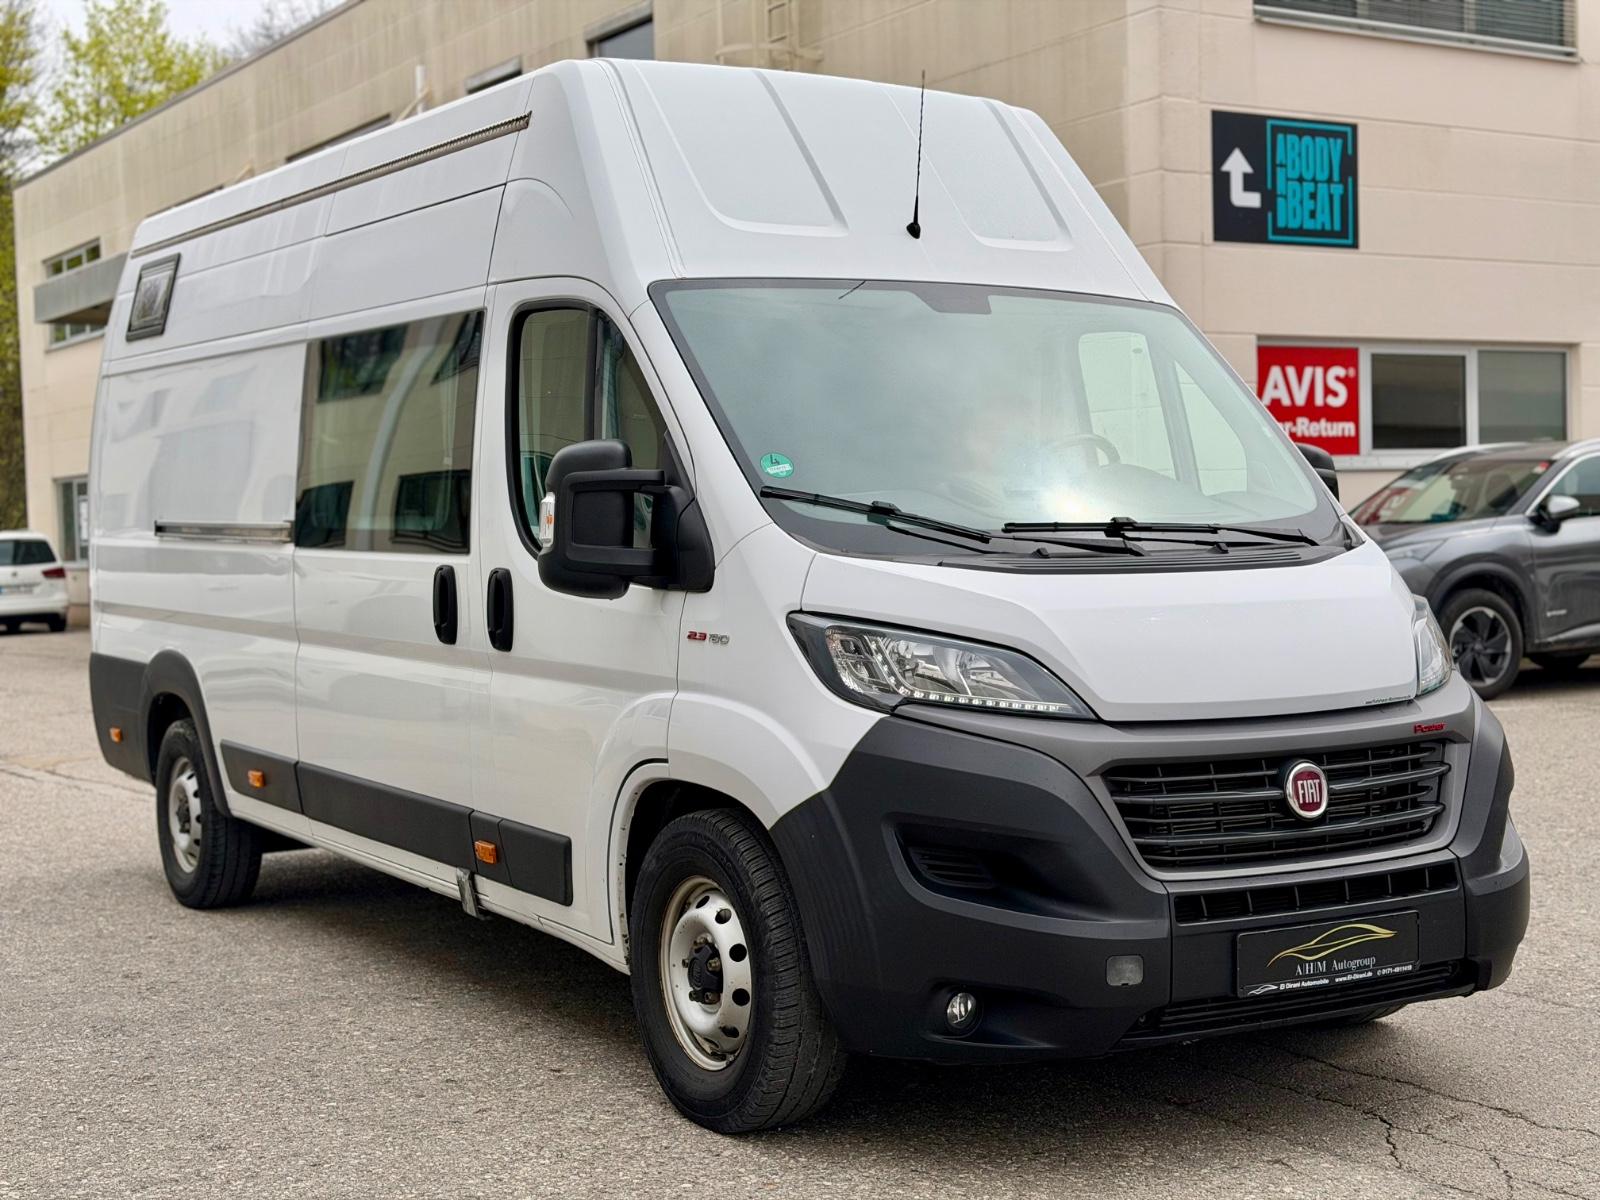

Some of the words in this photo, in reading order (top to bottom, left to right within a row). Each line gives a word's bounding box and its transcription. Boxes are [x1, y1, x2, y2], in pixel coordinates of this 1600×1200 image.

[1286, 134, 1343, 181] BODY
[1287, 181, 1344, 231] BEAT
[1261, 365, 1348, 407] AVIS
[1281, 416, 1356, 438] r-Return
[1297, 779, 1321, 803] FIAT
[1331, 956, 1376, 971] Autogroup
